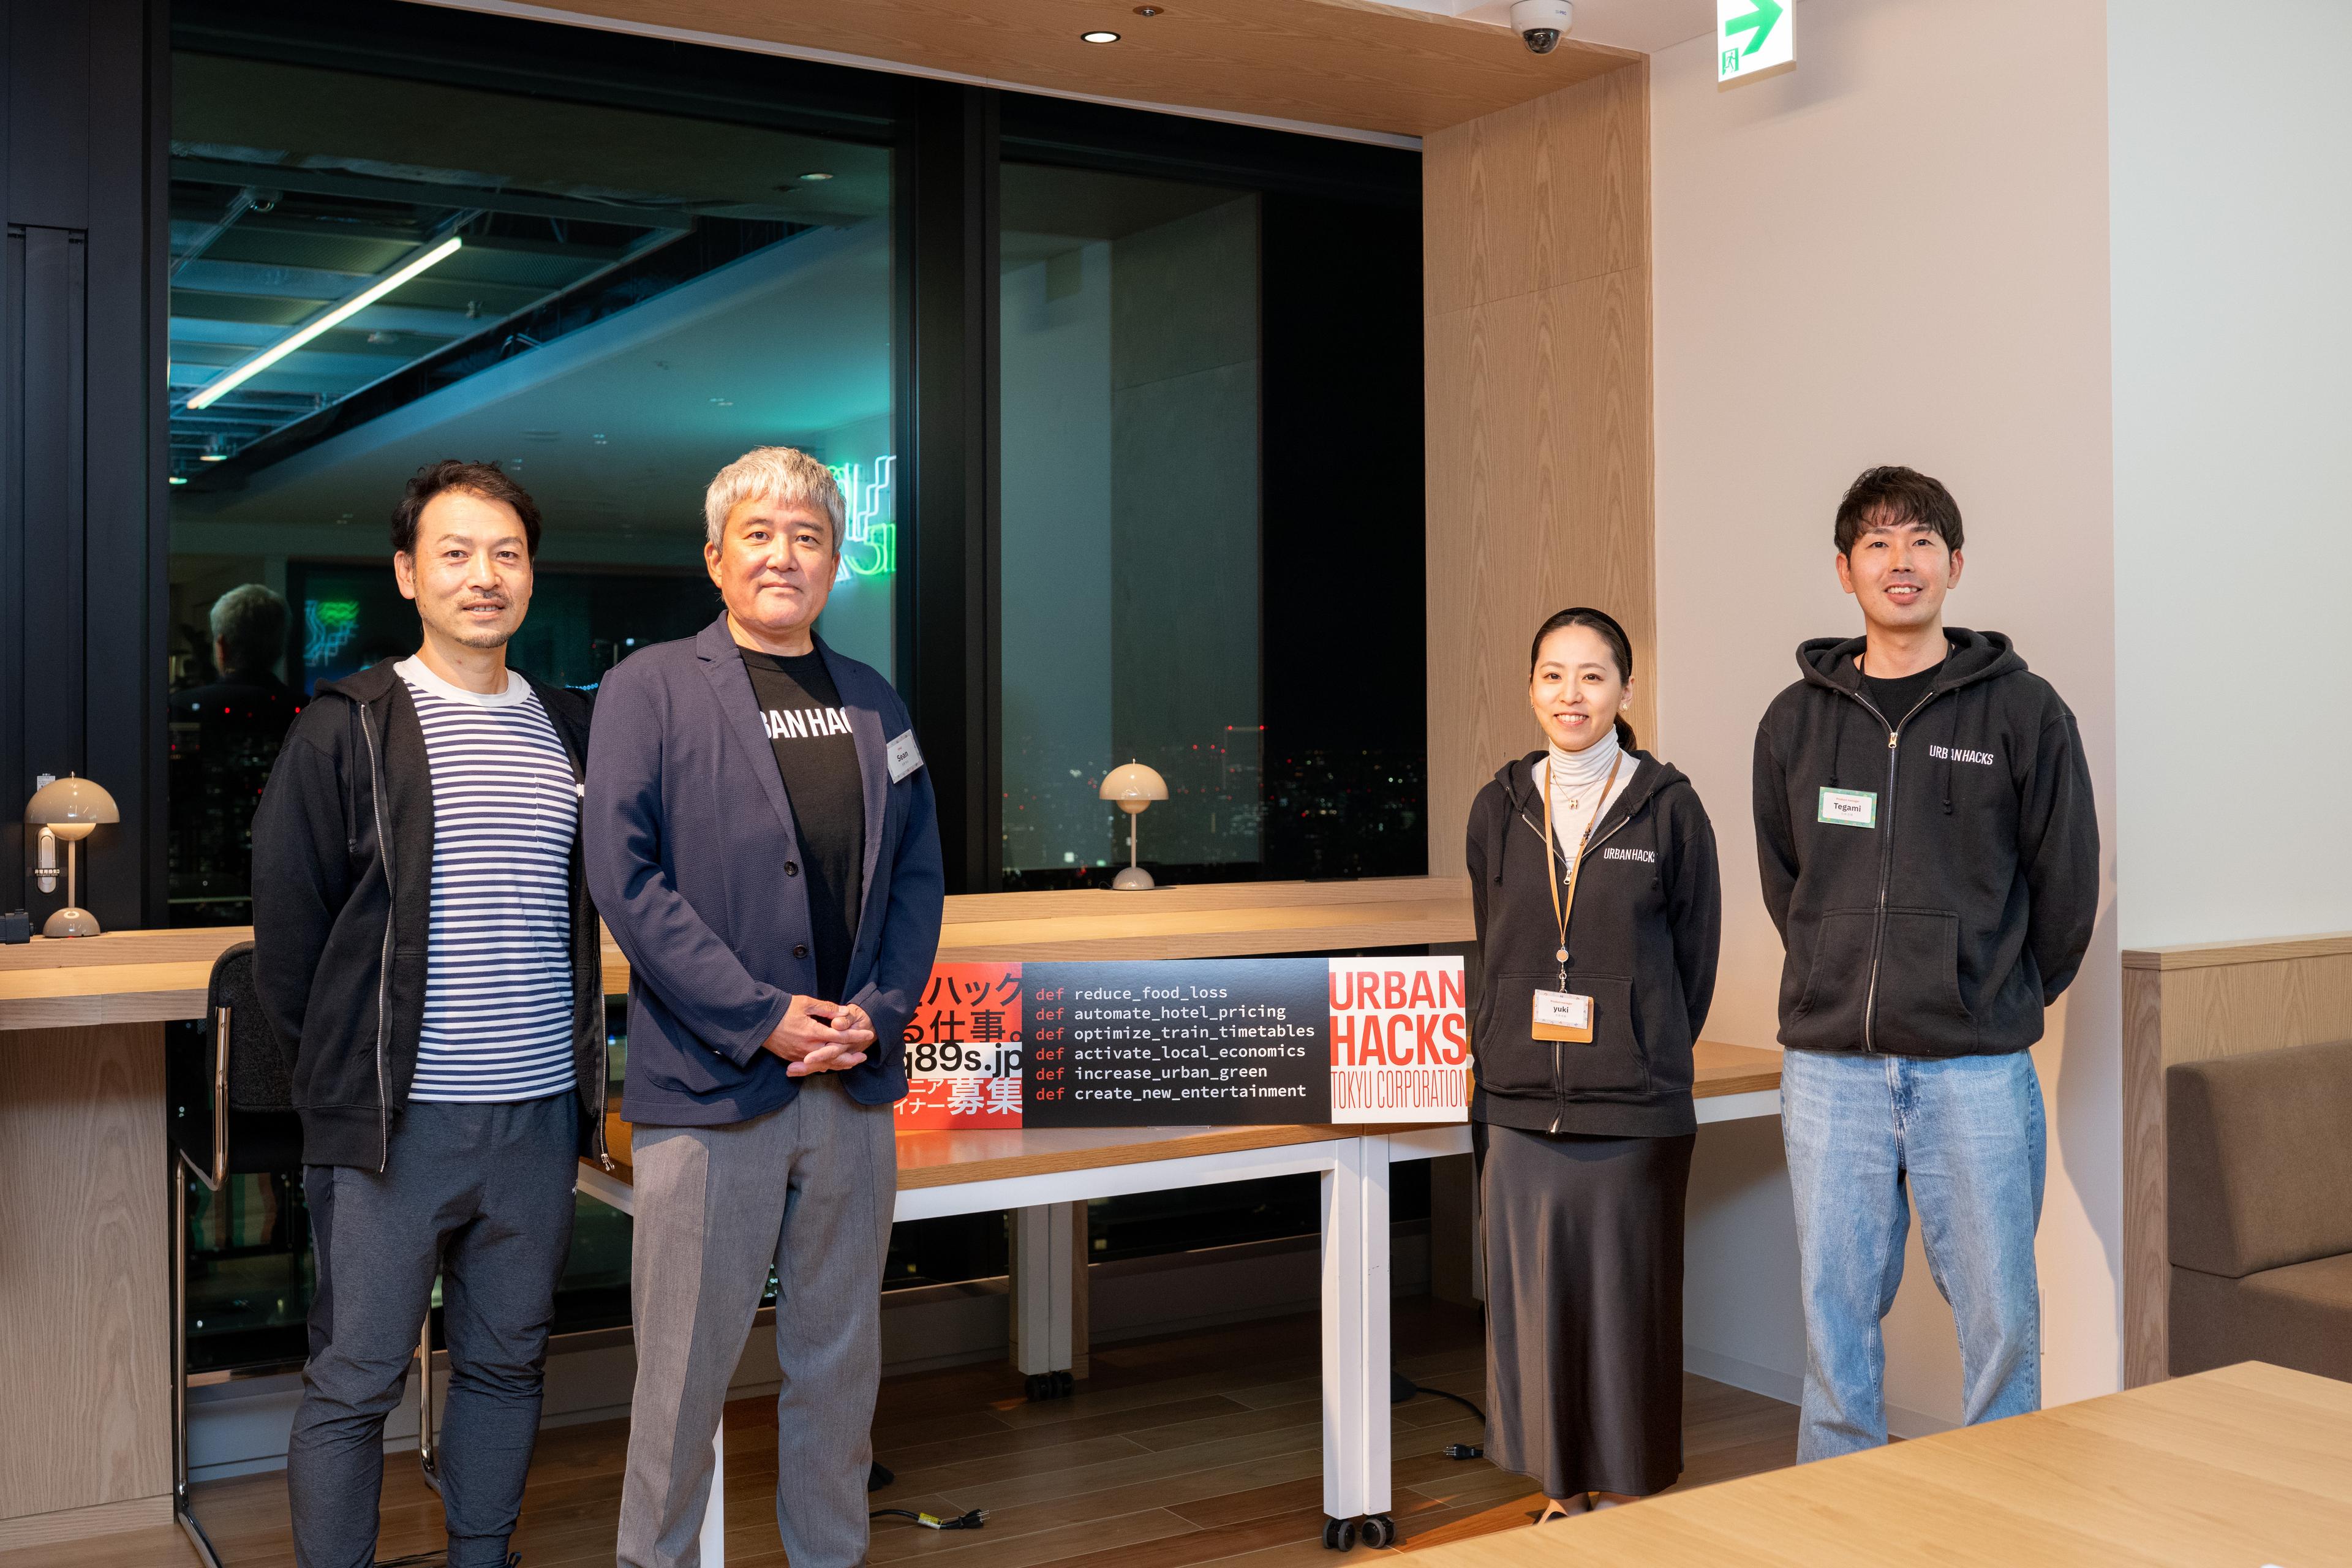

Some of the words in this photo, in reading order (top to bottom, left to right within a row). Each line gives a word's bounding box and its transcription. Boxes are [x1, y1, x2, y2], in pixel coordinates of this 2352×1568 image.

[897, 751, 909, 762] Sean
[1834, 802, 1861, 812] Tegami
[1632, 849, 1655, 863] HACK
[917, 973, 1022, 1007] ハック
[1036, 987, 1065, 1000] def
[1075, 986, 1227, 1001] reduce_food_loss
[1329, 970, 1466, 1011] URBAN
[1036, 1008, 1065, 1020] def
[1074, 1005, 1286, 1021] automate_hotel_pricing
[1036, 1027, 1065, 1040] def
[1074, 1024, 1315, 1042] optimize_train_timetables
[1330, 1013, 1467, 1066] HACKS
[1036, 1047, 1065, 1060] def
[1074, 1044, 1305, 1061] activate_local_economics
[1036, 1067, 1065, 1080] def
[1075, 1066, 1267, 1081] increase_urban_green
[907, 1079, 944, 1095] ニア
[1036, 1087, 1065, 1100] def
[1075, 1084, 1306, 1101] create_new_entertainment
[1331, 1071, 1372, 1109] TOKYU
[1378, 1069, 1468, 1109] CORPORATION
[947, 1077, 1022, 1115] 募集
